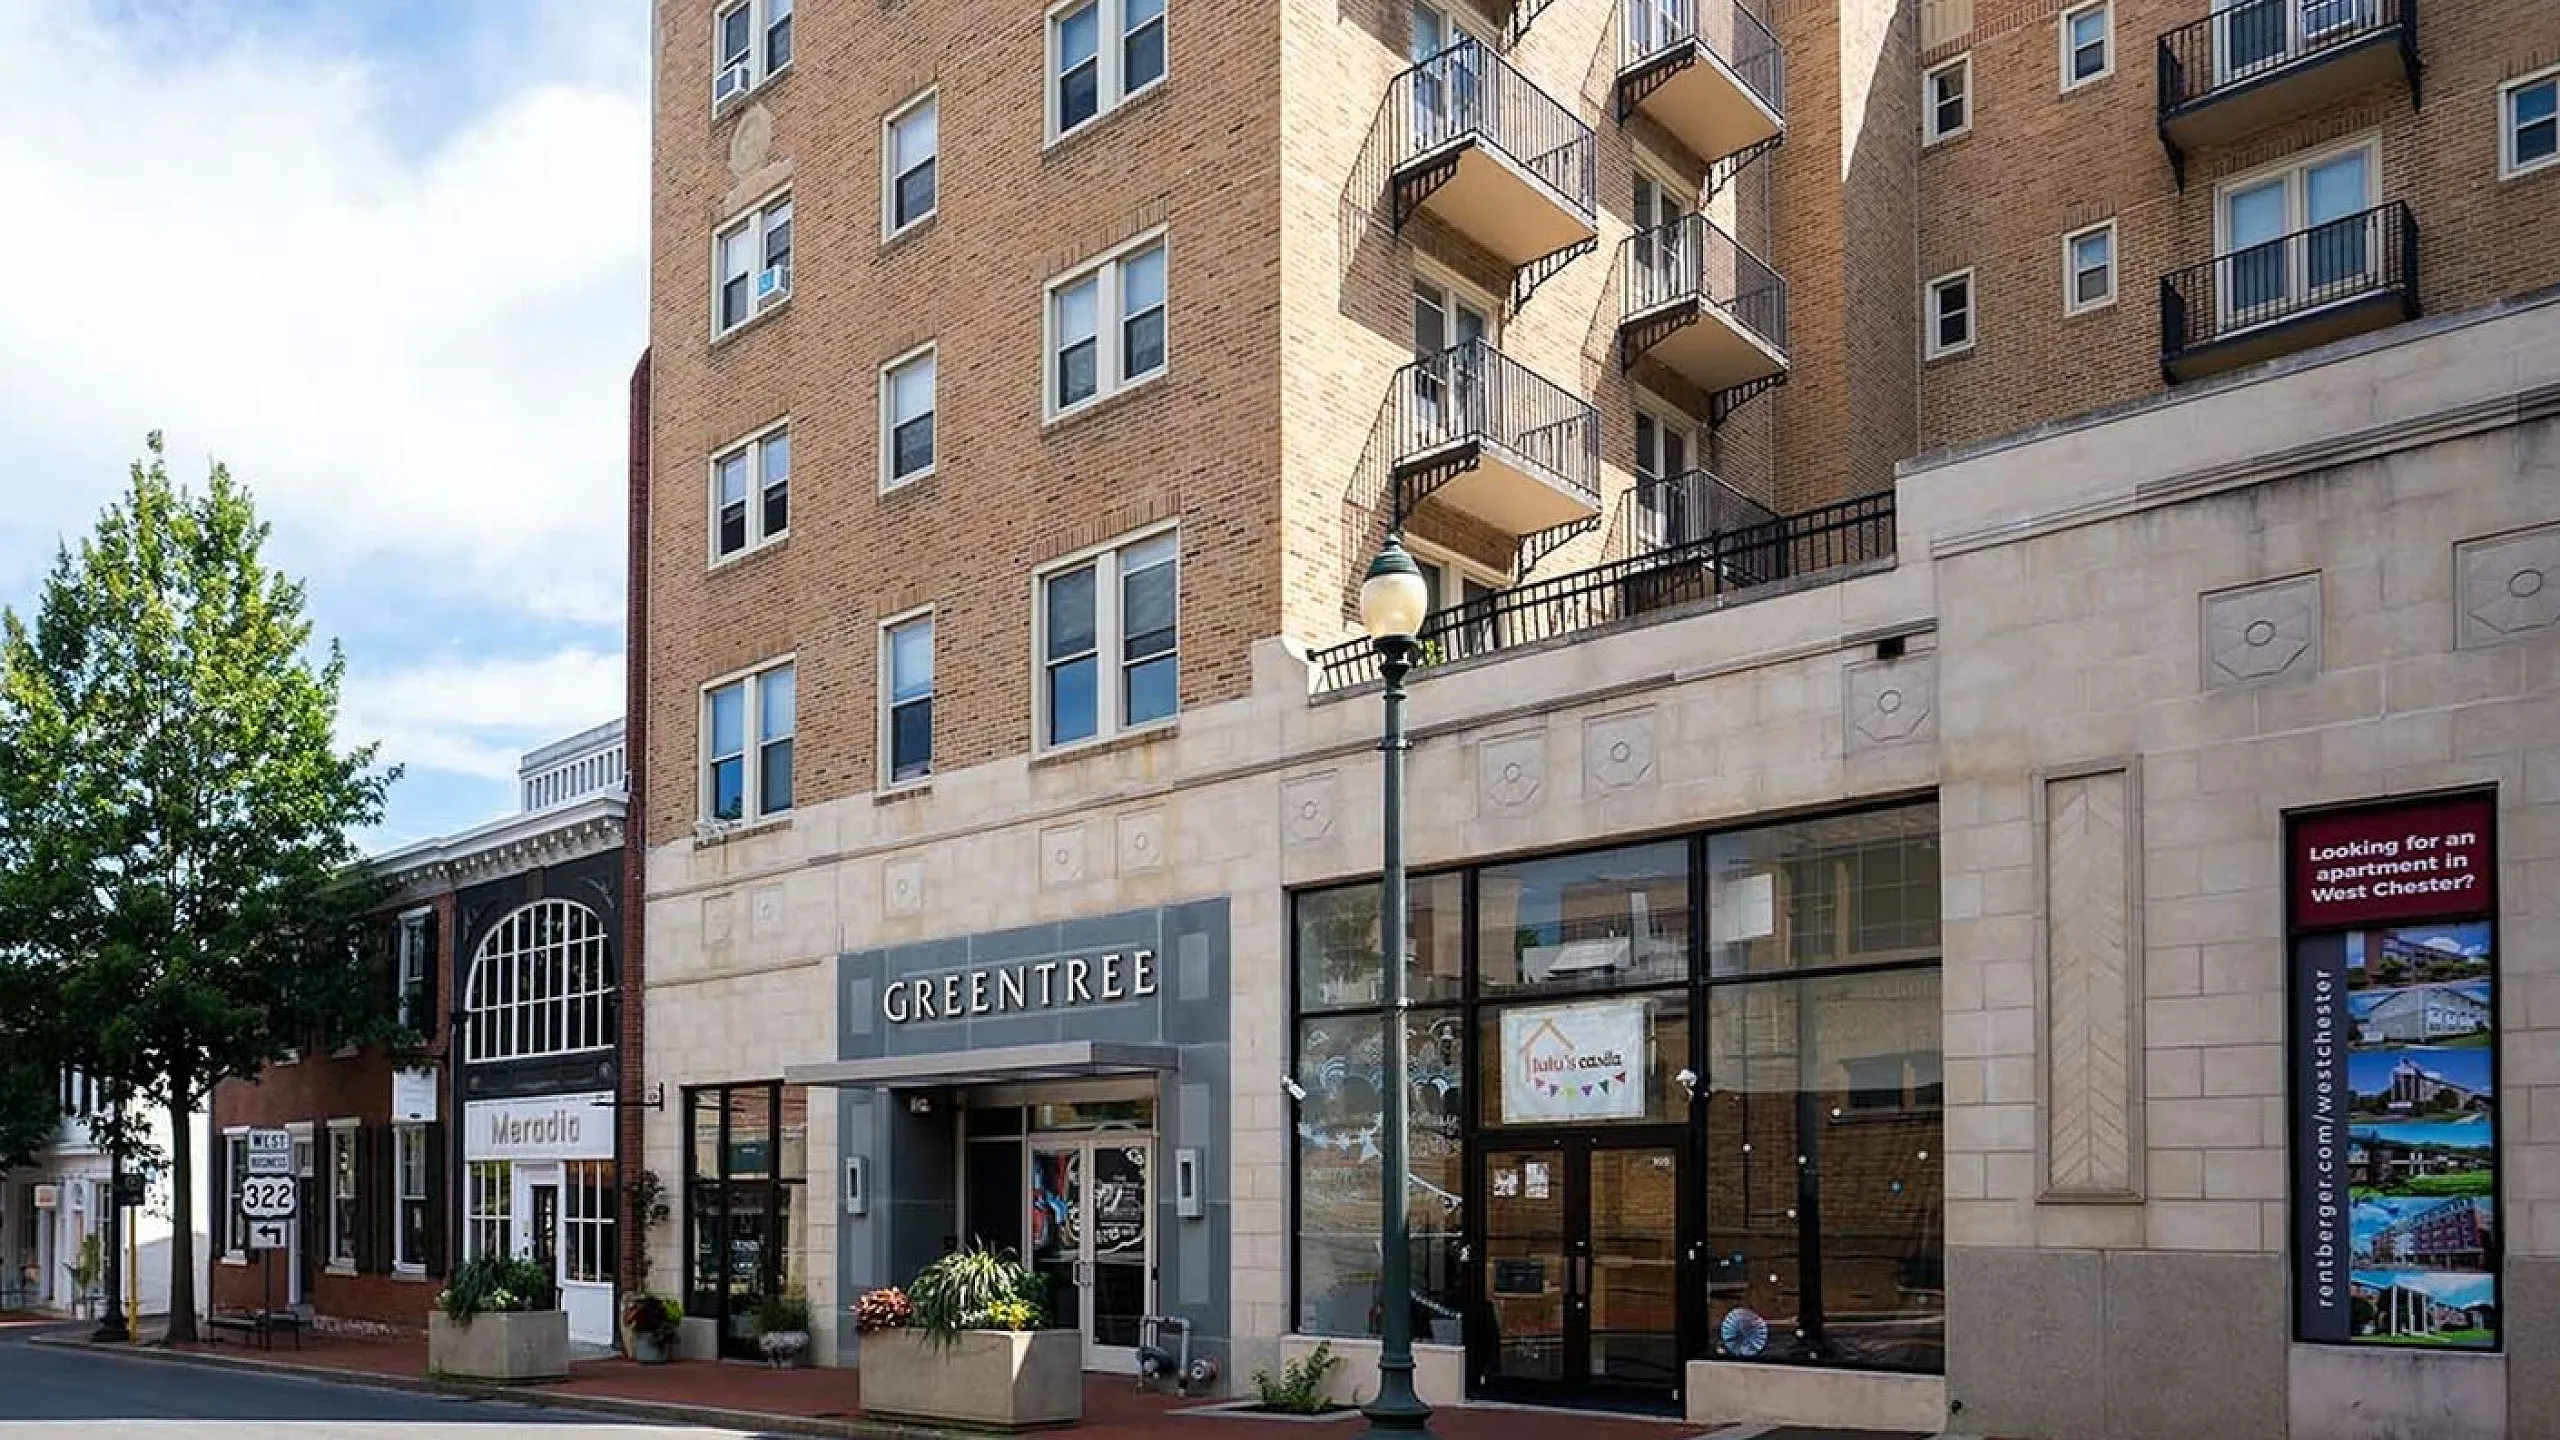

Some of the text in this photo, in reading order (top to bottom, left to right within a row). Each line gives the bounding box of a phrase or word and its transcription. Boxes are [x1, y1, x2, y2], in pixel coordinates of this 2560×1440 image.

[2309, 831, 2476, 862] Looking for an
[2316, 852, 2468, 883] apartment in
[2311, 873, 2475, 902] West Chester?
[884, 950, 1157, 1022] GREENTREE
[2313, 969, 2338, 1308] rentberger.com/westchester
[245, 1184, 290, 1208] 322
